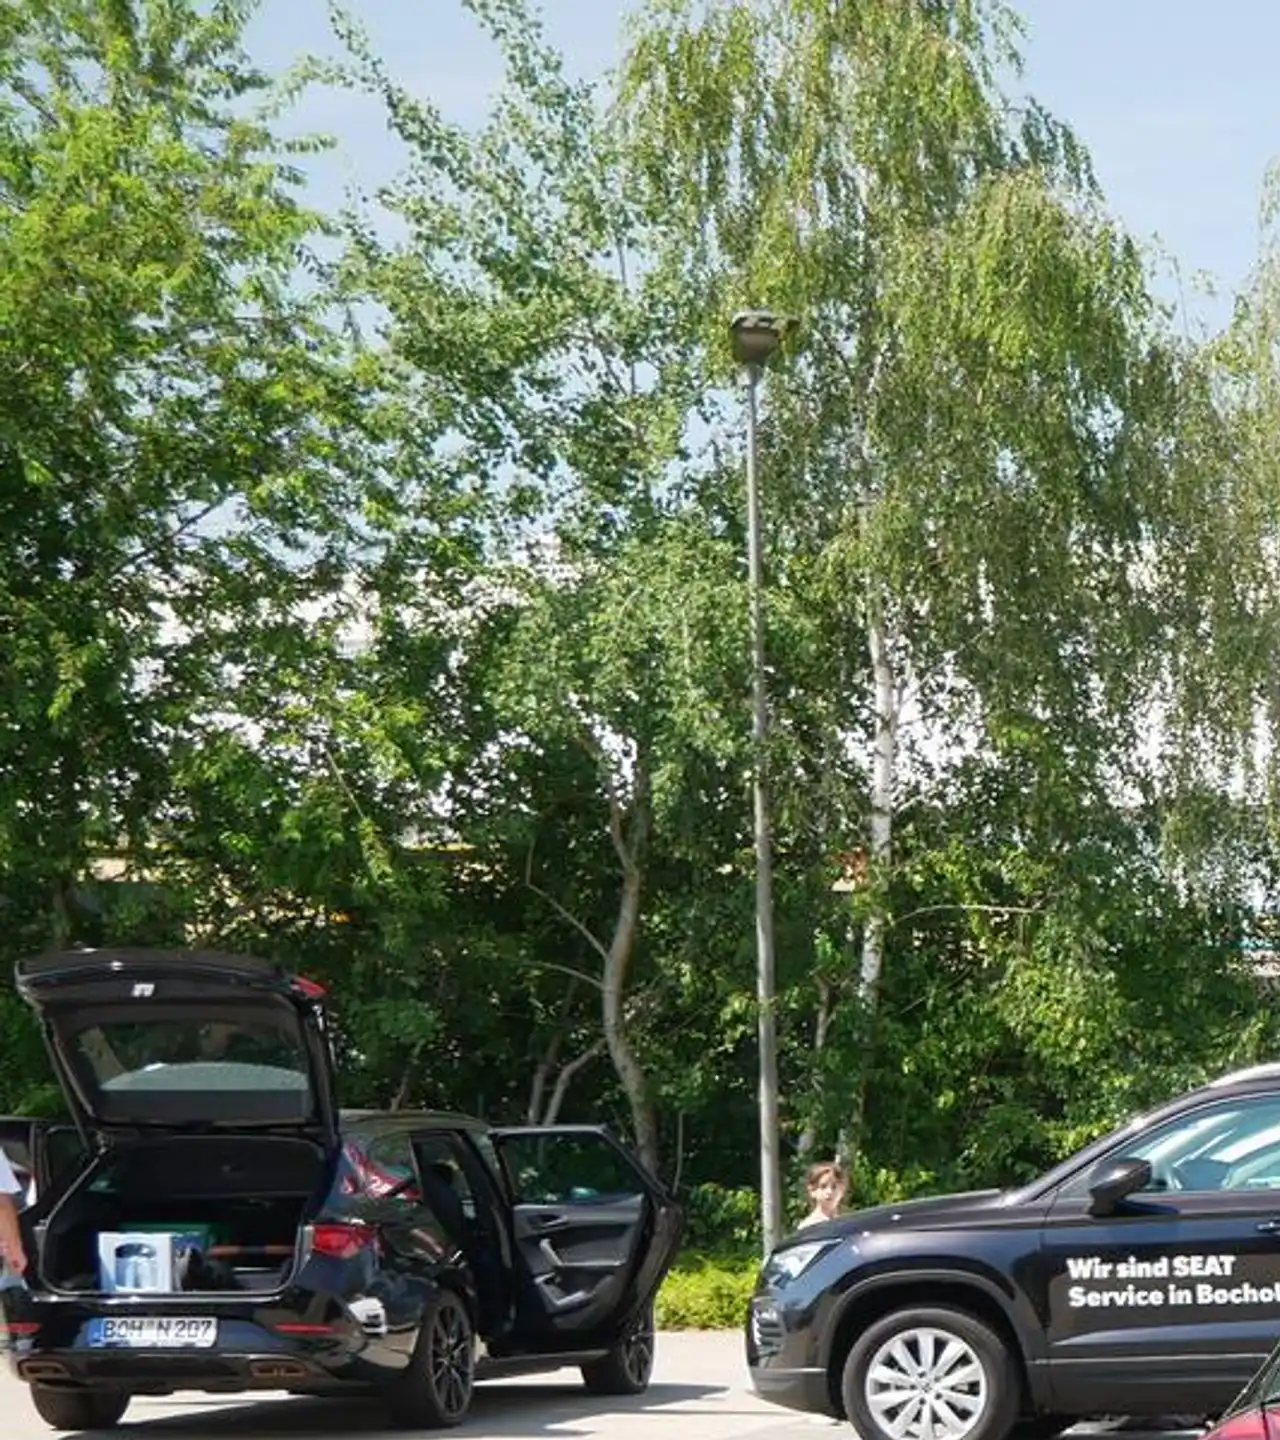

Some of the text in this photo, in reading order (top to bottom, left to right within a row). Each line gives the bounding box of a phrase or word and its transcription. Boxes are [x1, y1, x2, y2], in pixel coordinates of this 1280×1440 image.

[1066, 1255, 1236, 1279] Wir sind SEAT
[1068, 1285, 1164, 1308] Service
[1168, 1284, 1192, 1306] in
